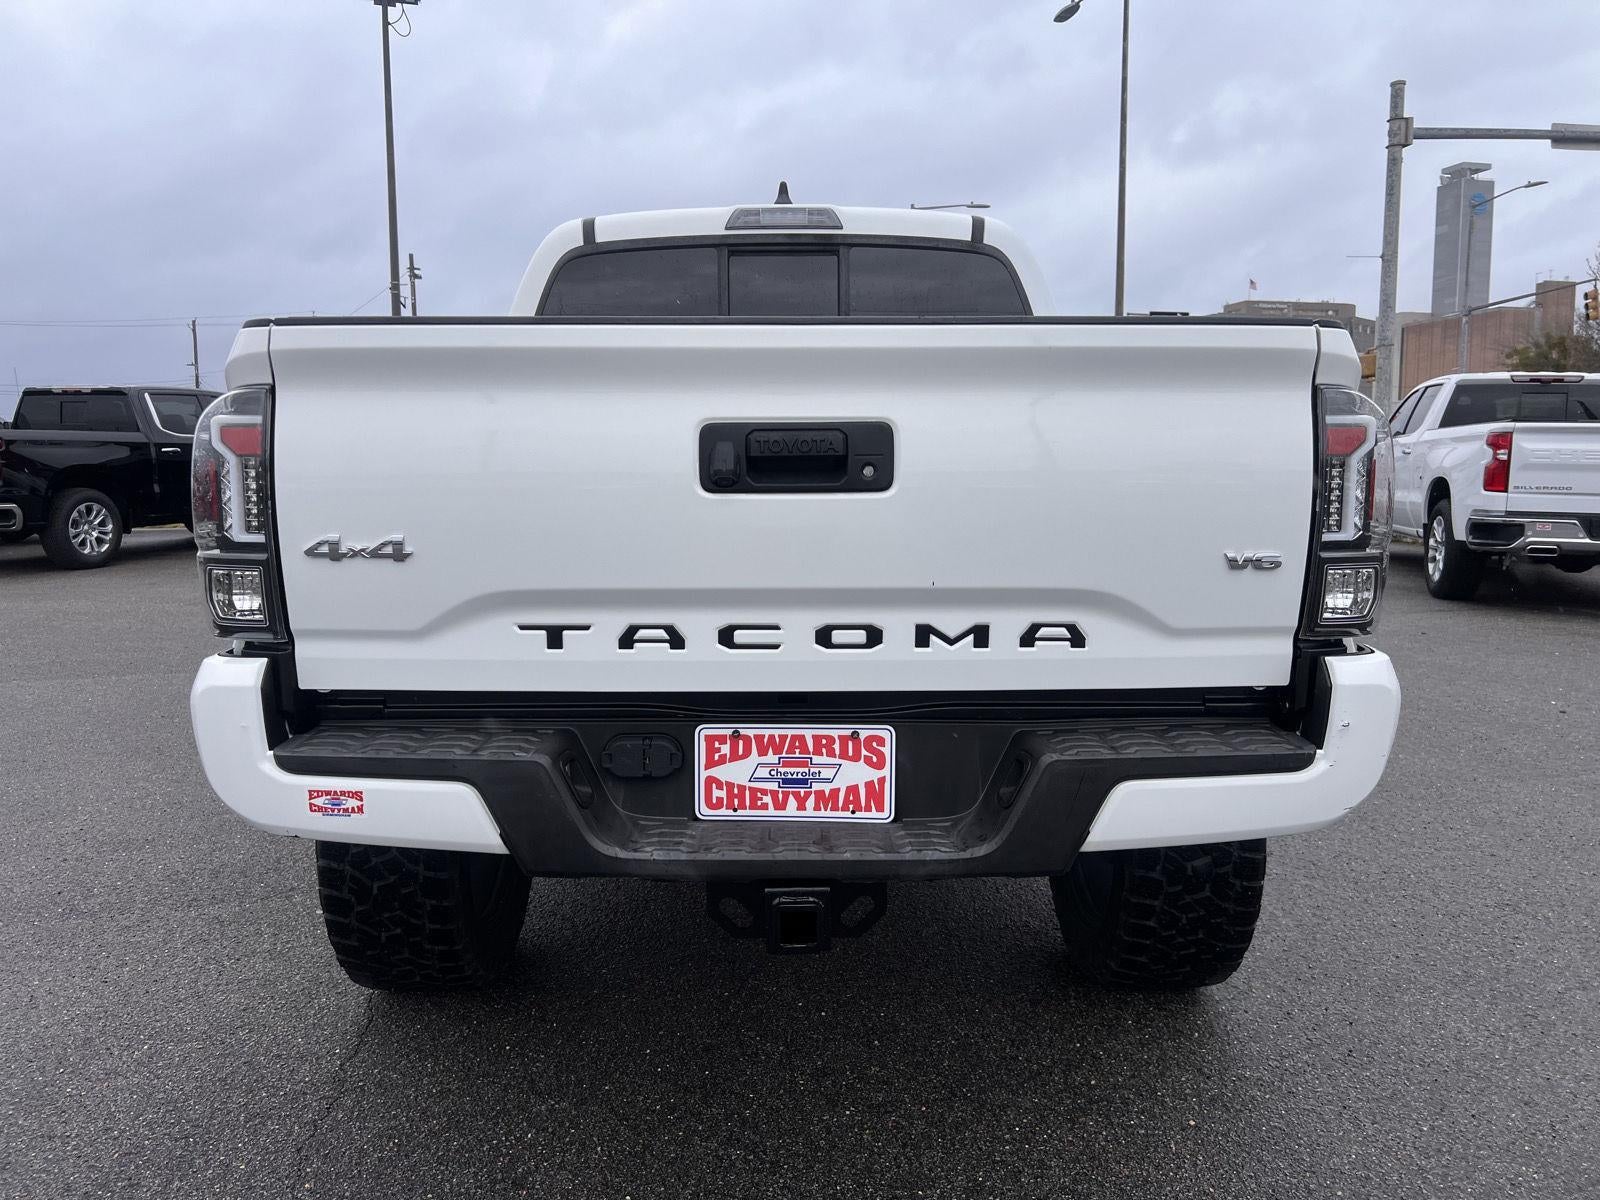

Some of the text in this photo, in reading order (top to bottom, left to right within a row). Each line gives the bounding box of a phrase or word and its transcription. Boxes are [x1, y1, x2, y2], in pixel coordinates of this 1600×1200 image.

[755, 437, 841, 455] TOYOTA
[303, 534, 413, 562] 4x4
[1223, 551, 1283, 570] V6
[514, 623, 1087, 651] TACOMA
[703, 733, 887, 771] EDWARDS
[768, 768, 822, 778] Chevrolet
[307, 790, 364, 802] EDWARDS
[703, 774, 887, 813] CHEVYMAN
